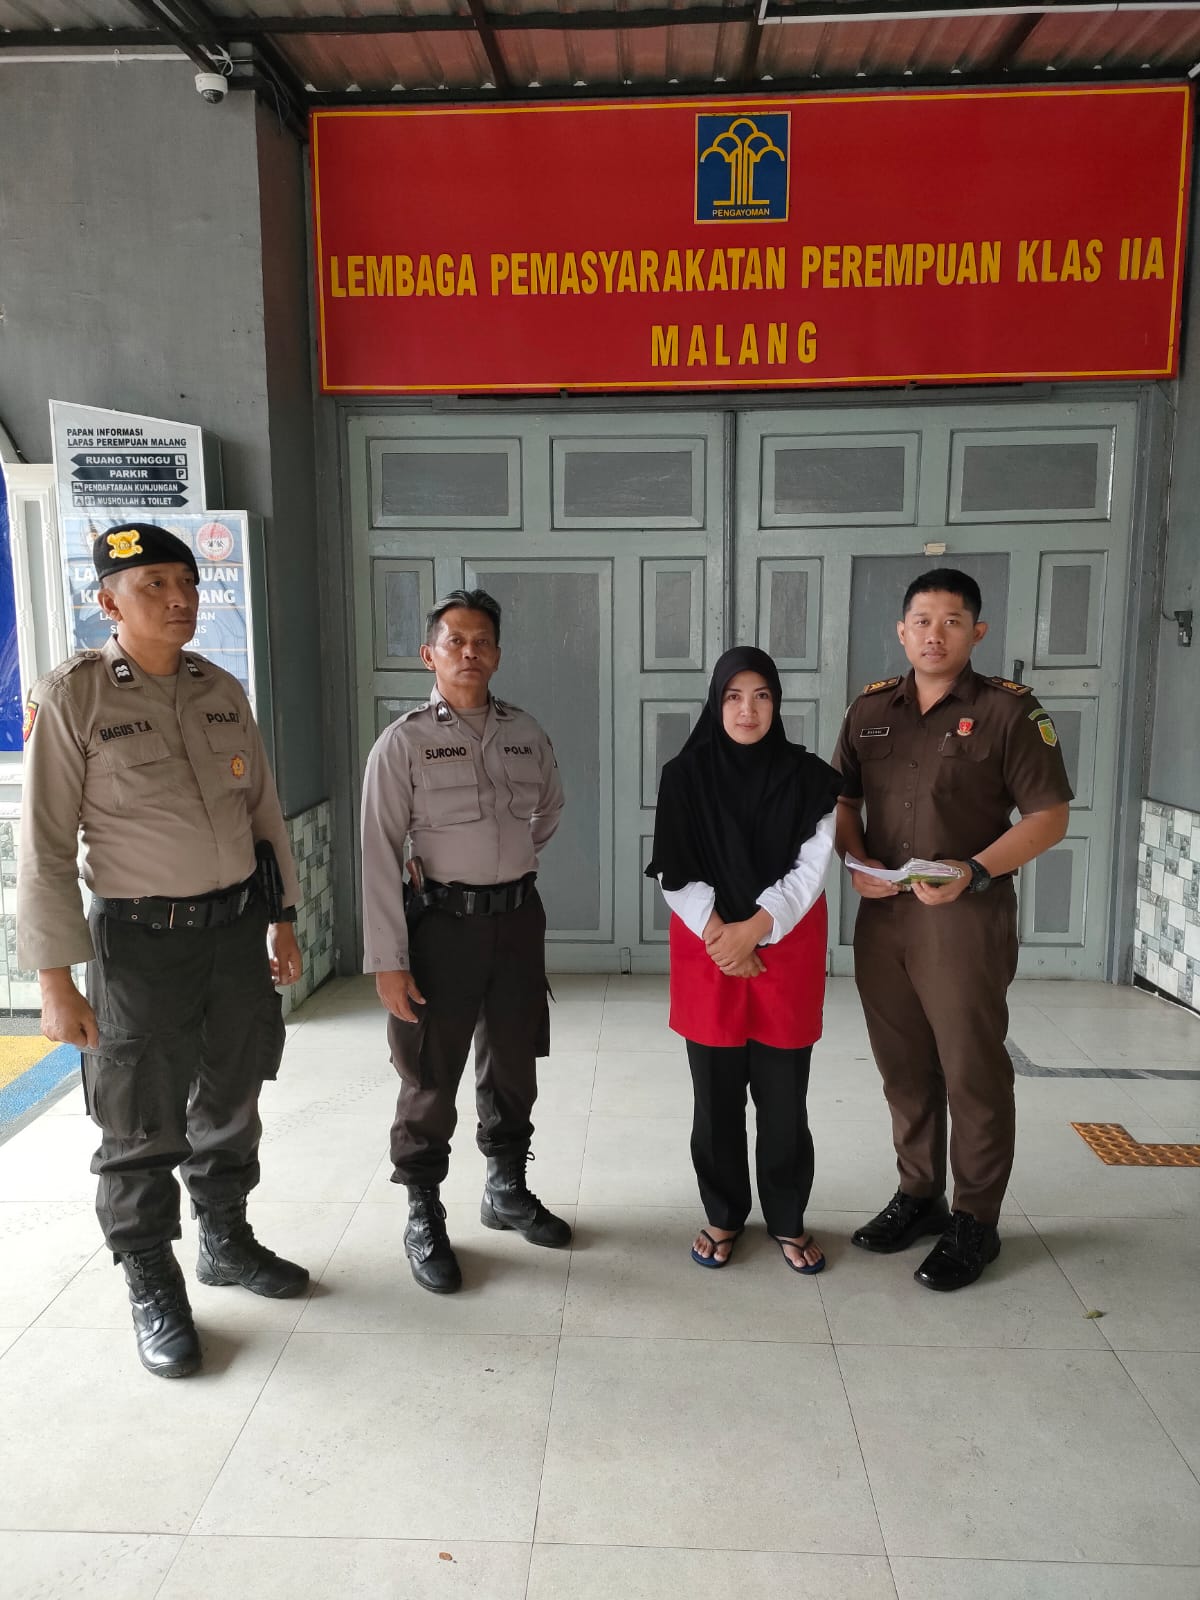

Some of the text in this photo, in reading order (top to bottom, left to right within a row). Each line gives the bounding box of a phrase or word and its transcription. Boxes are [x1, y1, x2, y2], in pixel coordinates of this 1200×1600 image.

[712, 204, 770, 217] PENGAYOMAN
[330, 236, 1165, 299] LEMBAGA PEMASYARAKATAN PEREMPUAN KLAS IIA
[651, 320, 818, 368] MALANG
[67, 428, 143, 437] PAPAN INFORMASI
[67, 438, 187, 447] LAPAS PEREMPUAN MALANG
[85, 456, 171, 465] RUANG TUNGGU
[109, 469, 148, 479] PARKIR
[84, 483, 178, 492] PENDAFTARAN KUNJUNGAN
[147, 496, 172, 505] TOILET
[206, 712, 241, 724] POLRI
[100, 724, 135, 742] BAGUS
[425, 746, 467, 760] SURONO
[503, 746, 533, 755] POLRI
